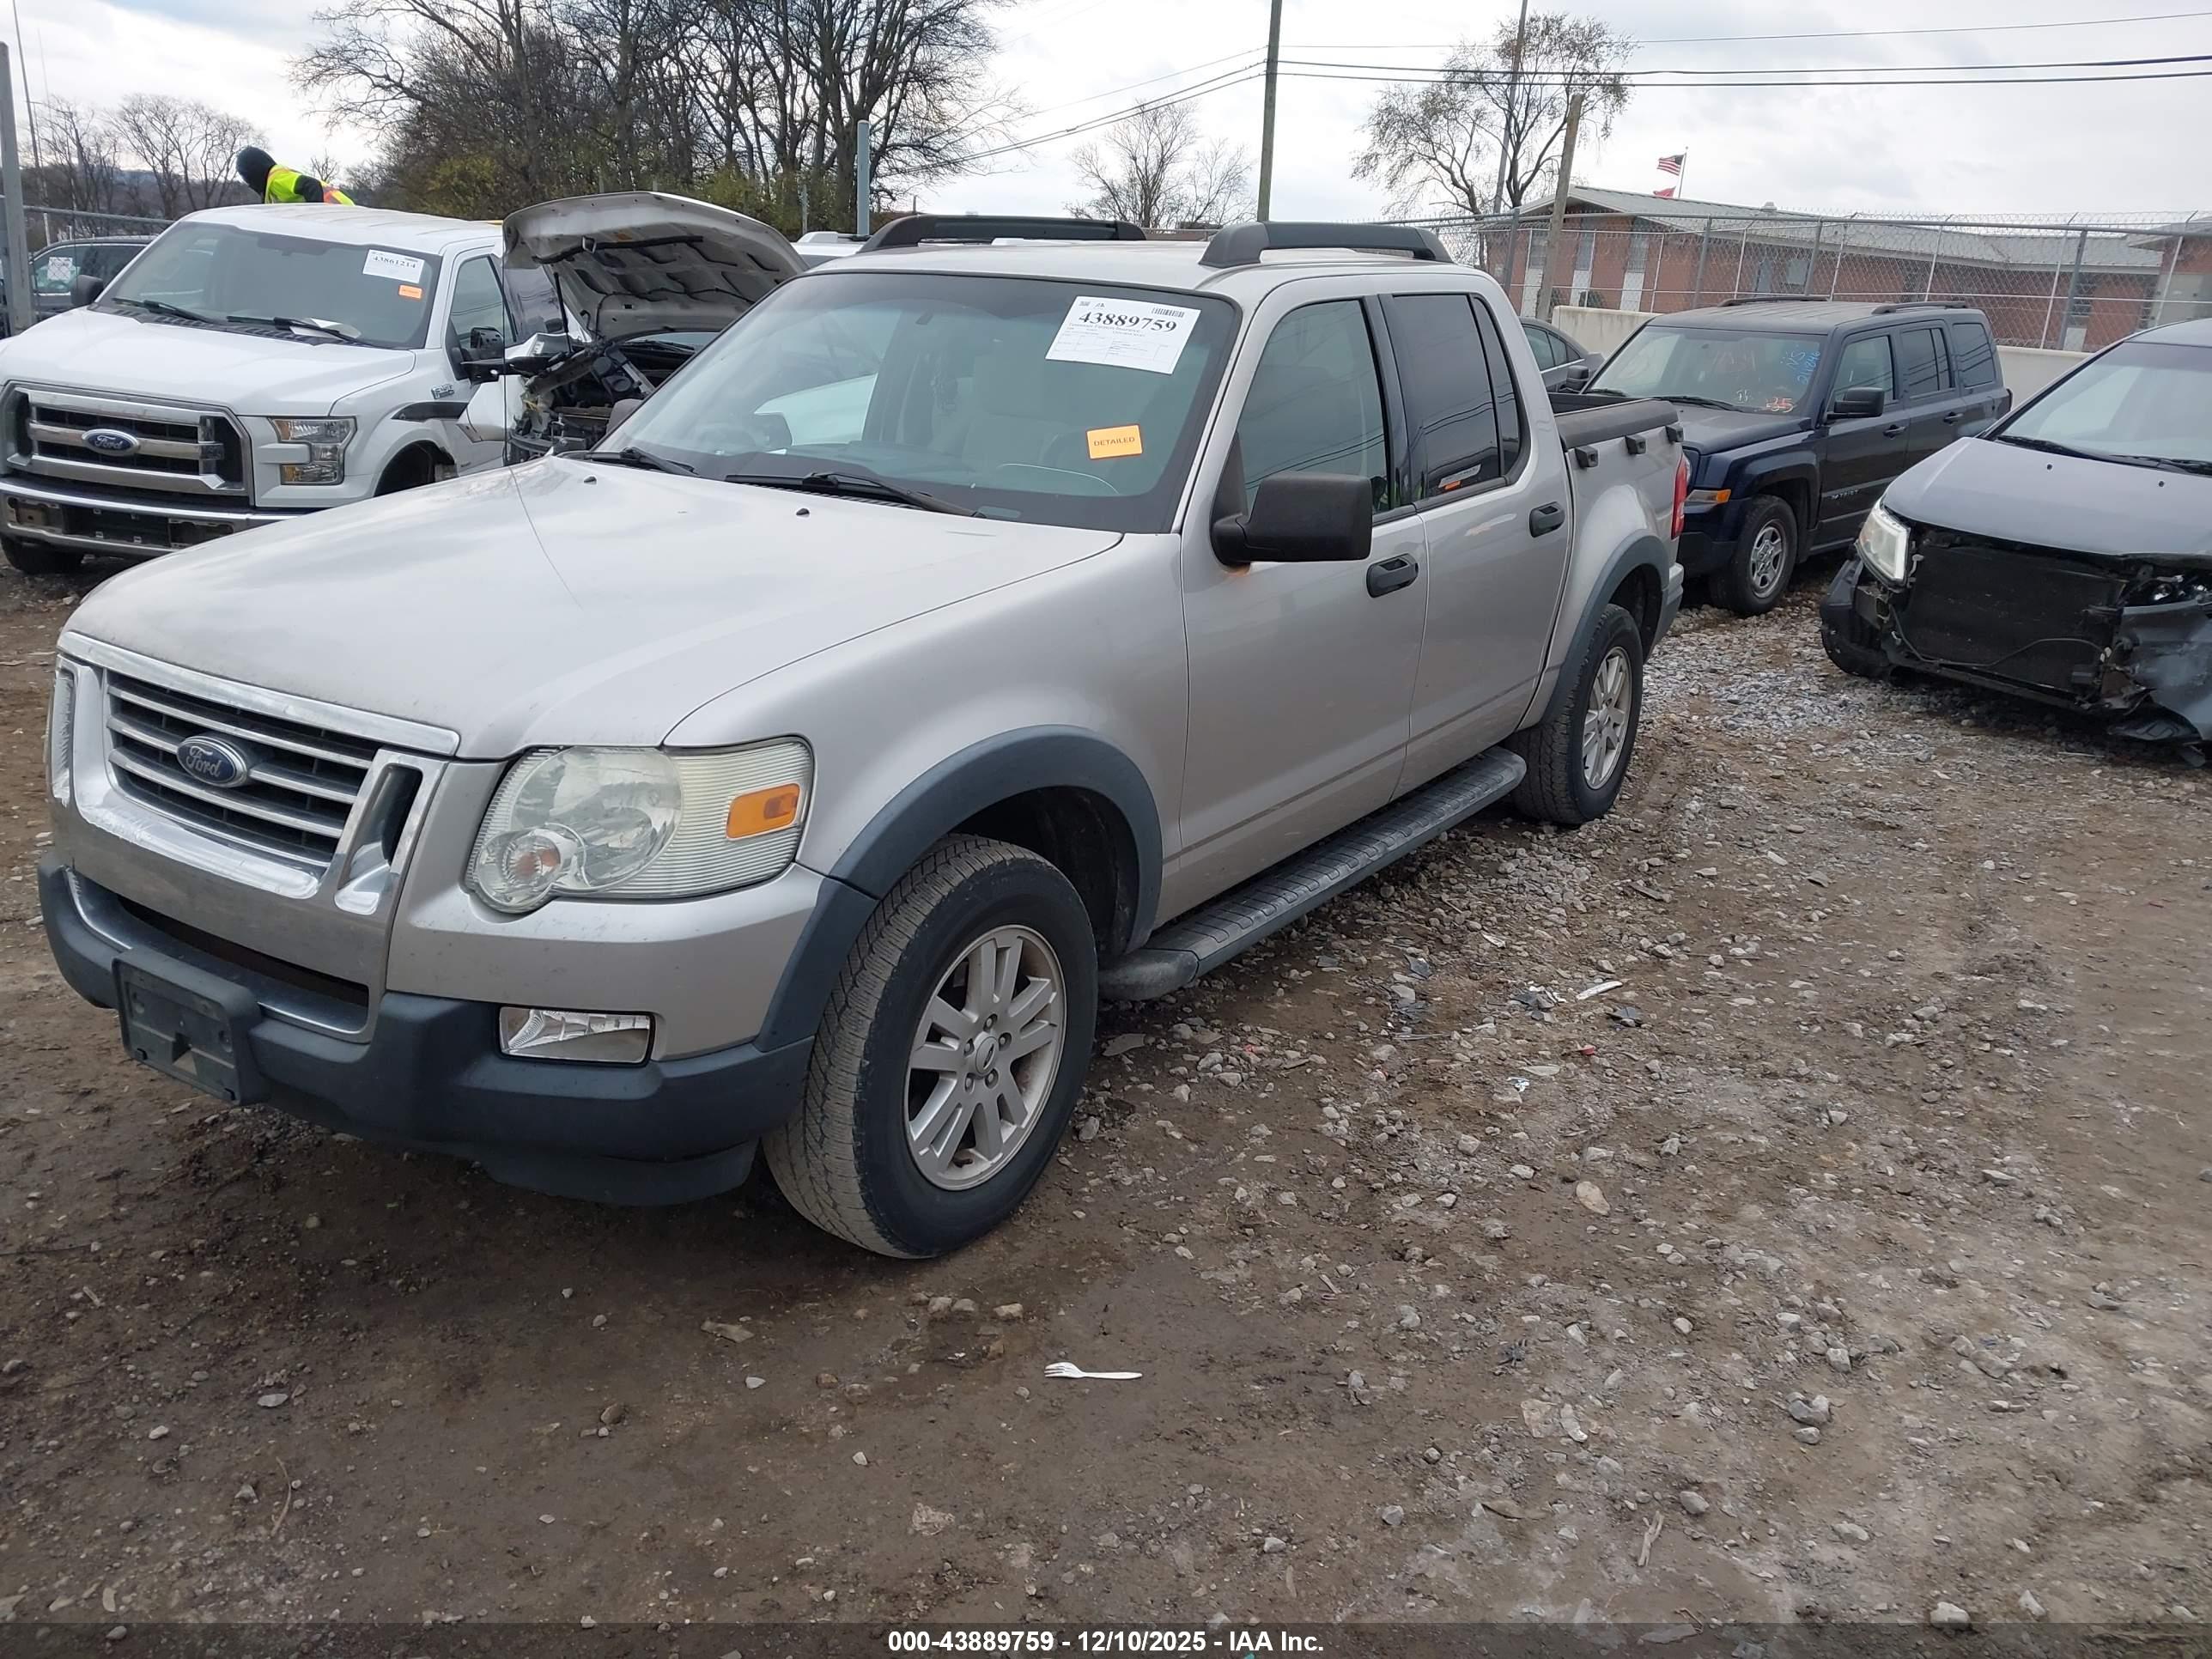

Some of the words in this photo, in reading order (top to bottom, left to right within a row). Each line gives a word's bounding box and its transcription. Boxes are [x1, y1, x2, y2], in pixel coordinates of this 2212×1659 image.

[1079, 312, 1177, 332] 43889759
[95, 434, 124, 449] Ford
[1093, 436, 1135, 447] DETAILED
[185, 745, 222, 777] Ford
